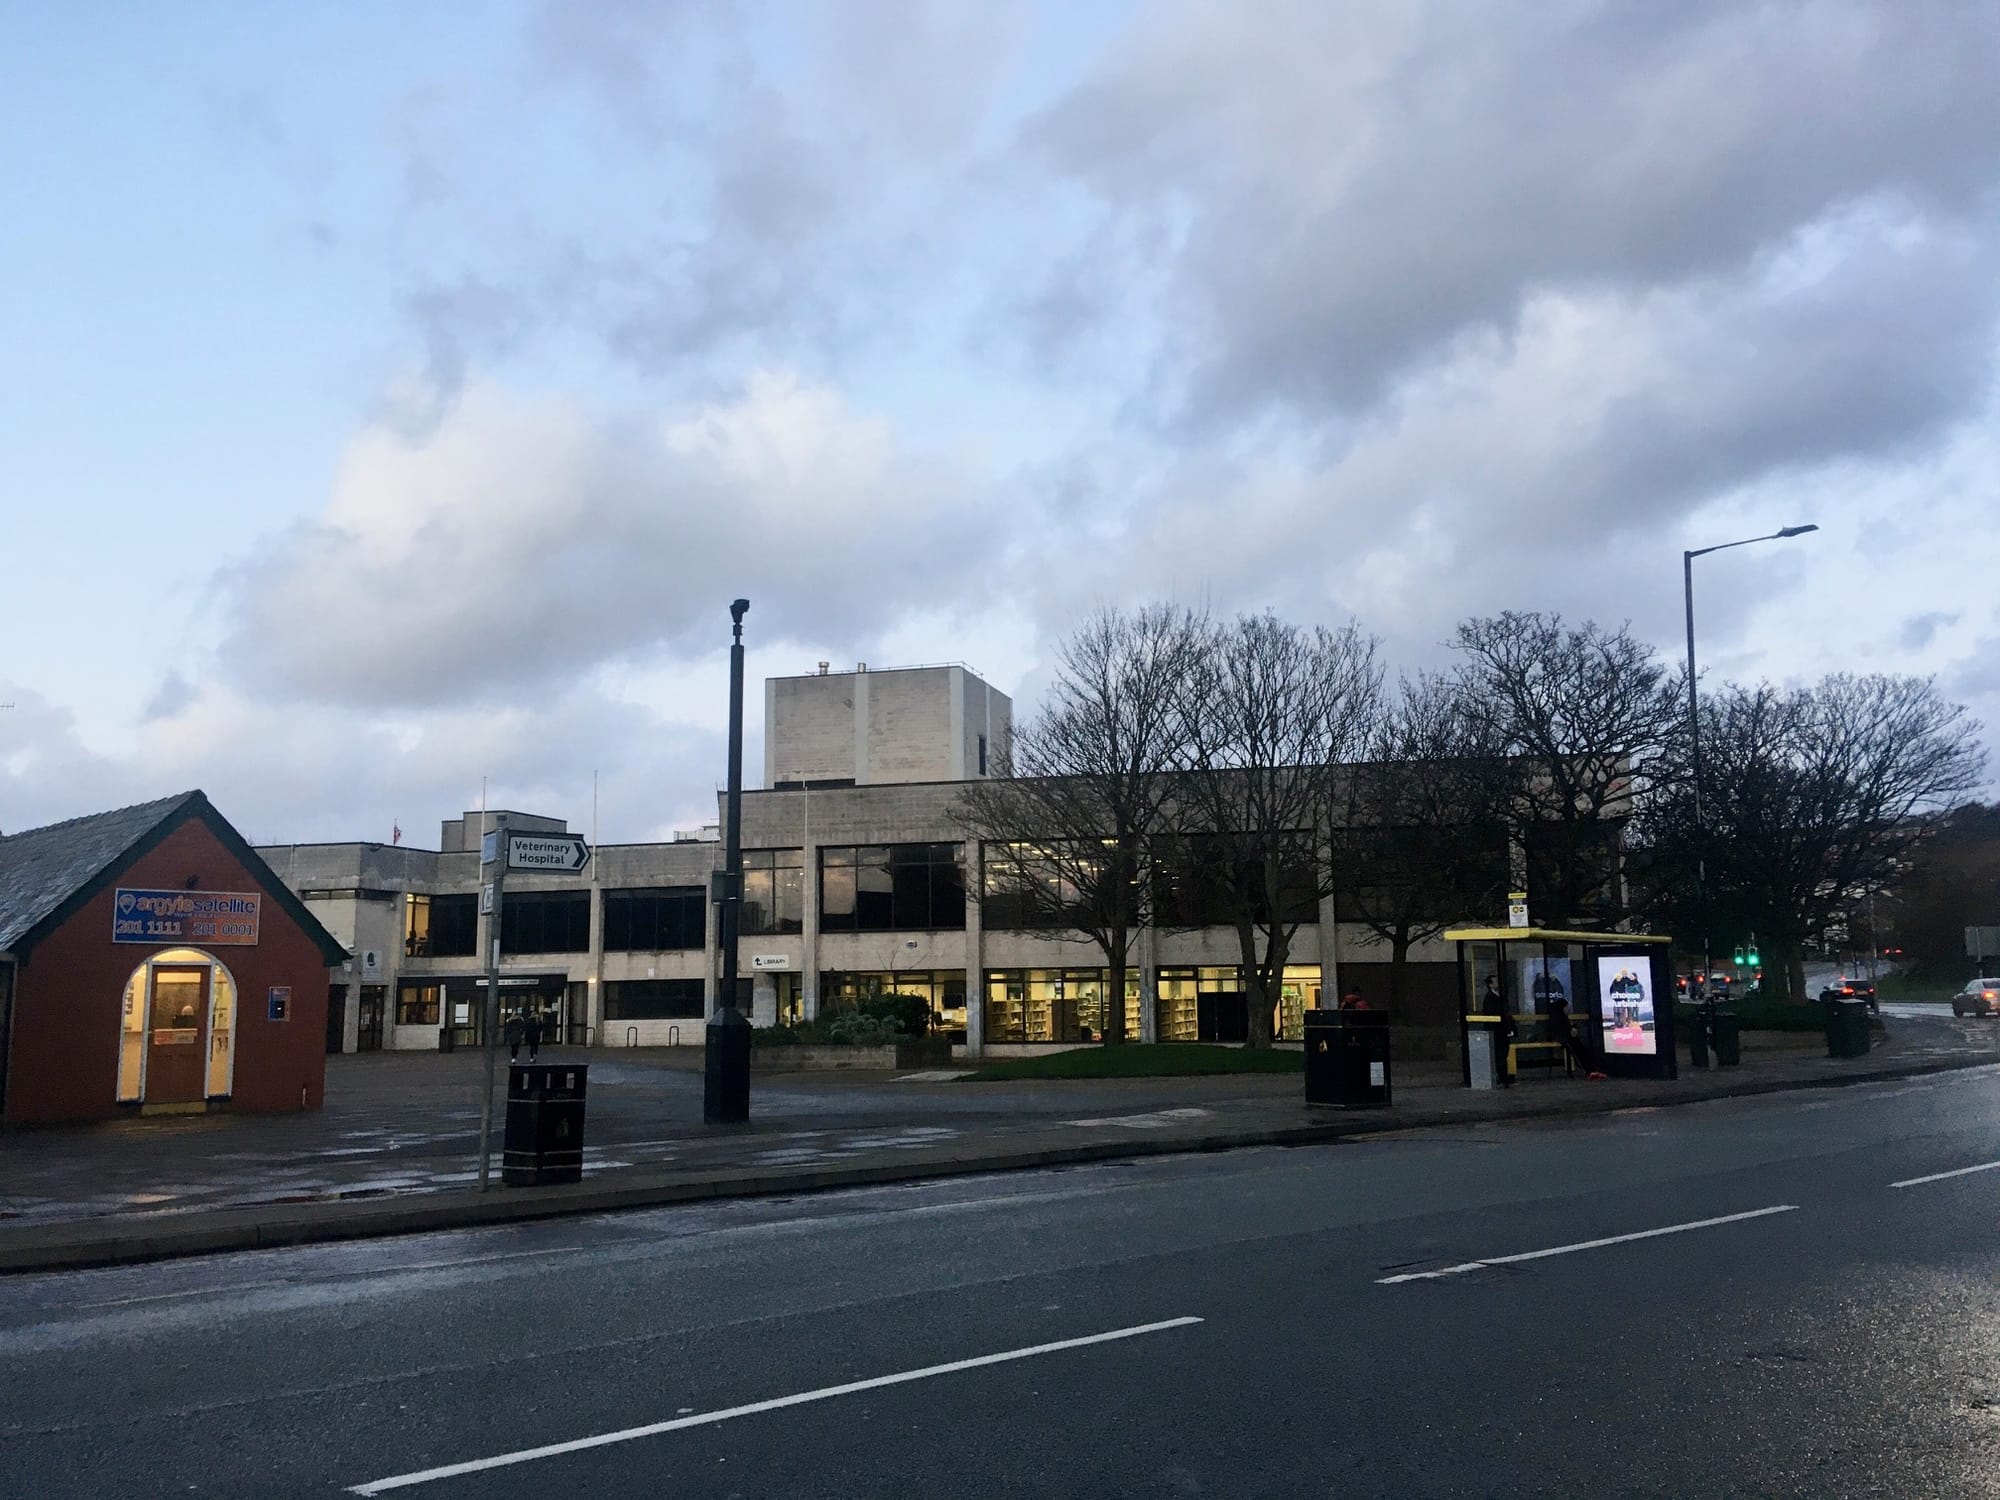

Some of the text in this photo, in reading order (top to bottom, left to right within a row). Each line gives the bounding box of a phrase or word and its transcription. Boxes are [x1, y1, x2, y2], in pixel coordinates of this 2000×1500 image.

[515, 841, 570, 854] Veterinary
[519, 853, 564, 864] Hospital
[116, 919, 254, 937] 201 1111 201 0001
[1611, 991, 1640, 999] choose
